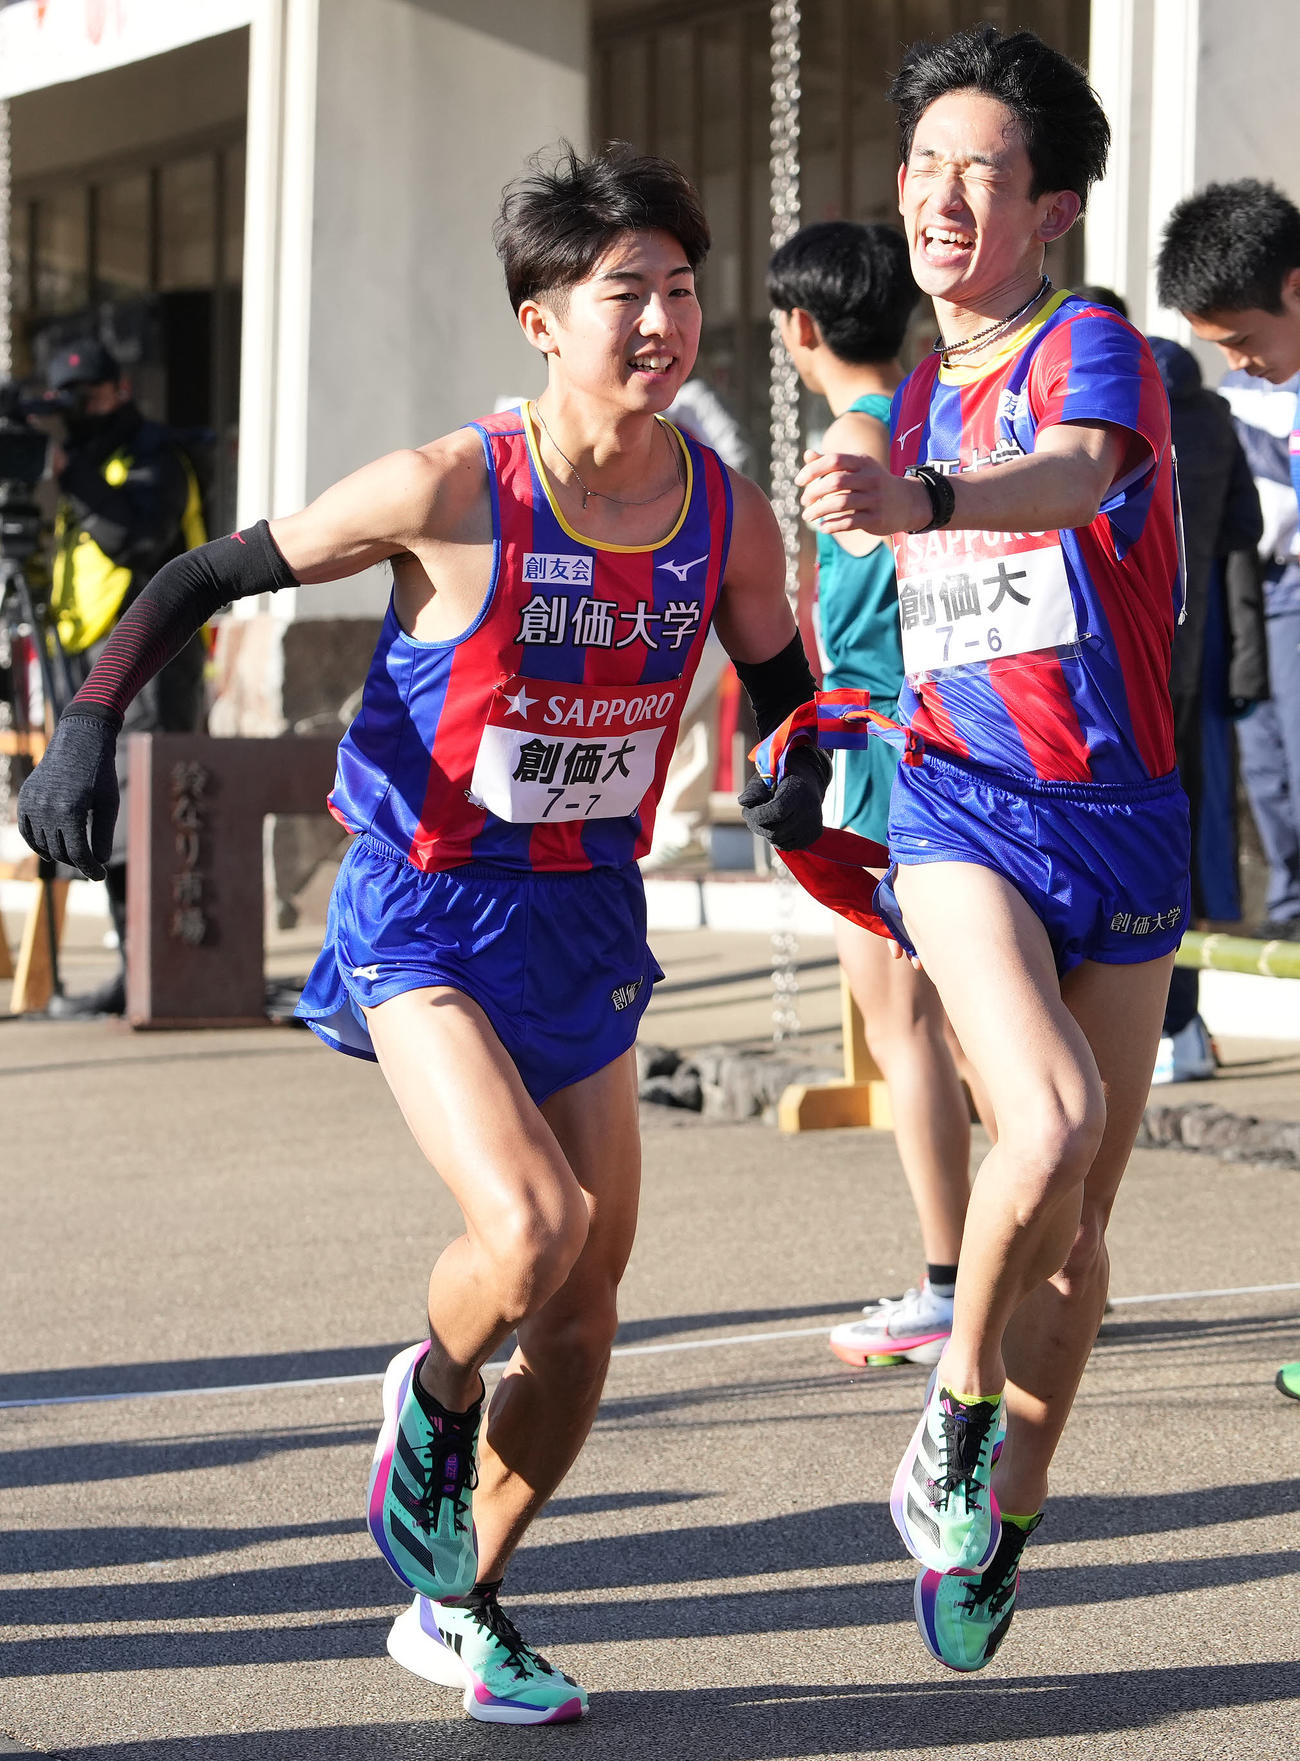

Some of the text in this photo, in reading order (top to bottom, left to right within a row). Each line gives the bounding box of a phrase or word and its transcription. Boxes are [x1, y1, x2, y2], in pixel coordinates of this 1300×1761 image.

[525, 556, 590, 581] 創友会
[900, 562, 1031, 631] 創価大
[516, 596, 701, 650] 創価大学
[936, 626, 1003, 662] 7-6
[543, 692, 675, 727] SAPPORO
[512, 738, 636, 785] 創価大
[542, 788, 601, 818] 7-7
[1110, 906, 1181, 934] 創価大学
